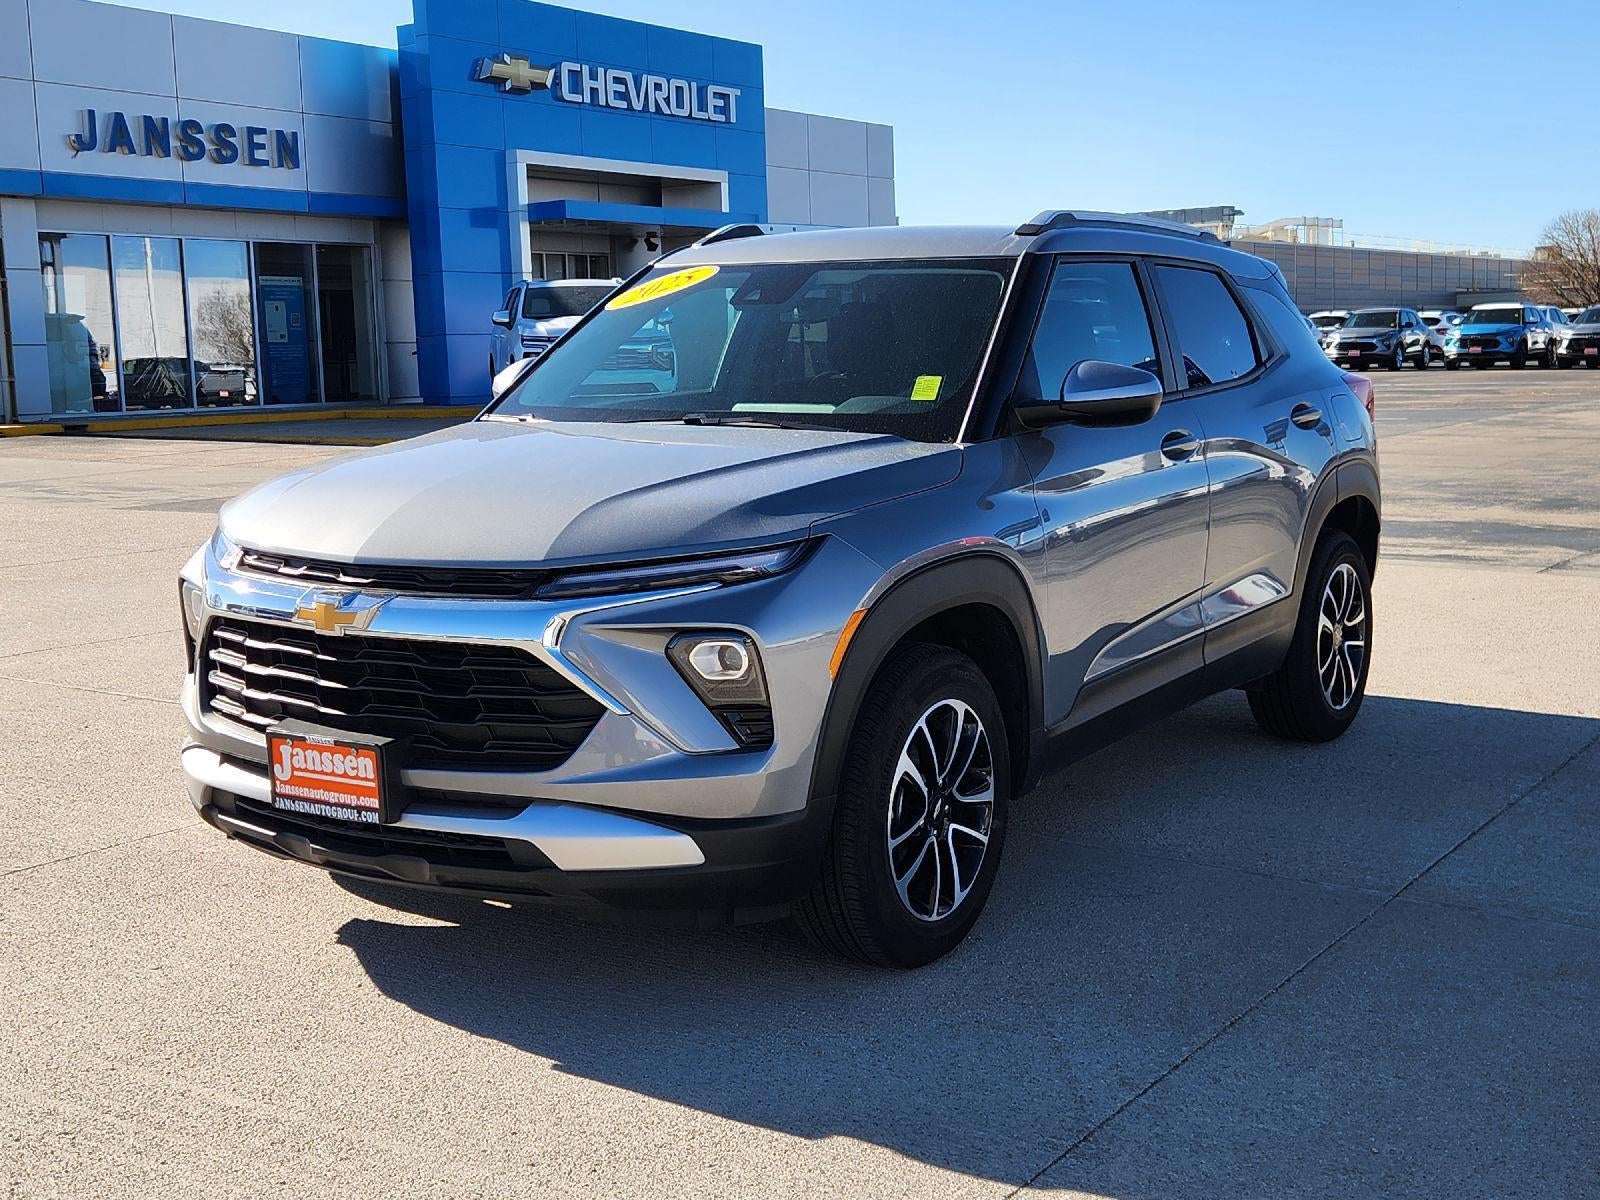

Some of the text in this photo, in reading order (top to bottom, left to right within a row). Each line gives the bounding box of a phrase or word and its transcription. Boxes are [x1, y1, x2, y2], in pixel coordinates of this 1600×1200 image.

[561, 61, 741, 123] CHEVROLET
[66, 108, 300, 170] JANSSEN
[273, 744, 375, 781] Janssen
[275, 780, 379, 809] Janssenautogroup.com
